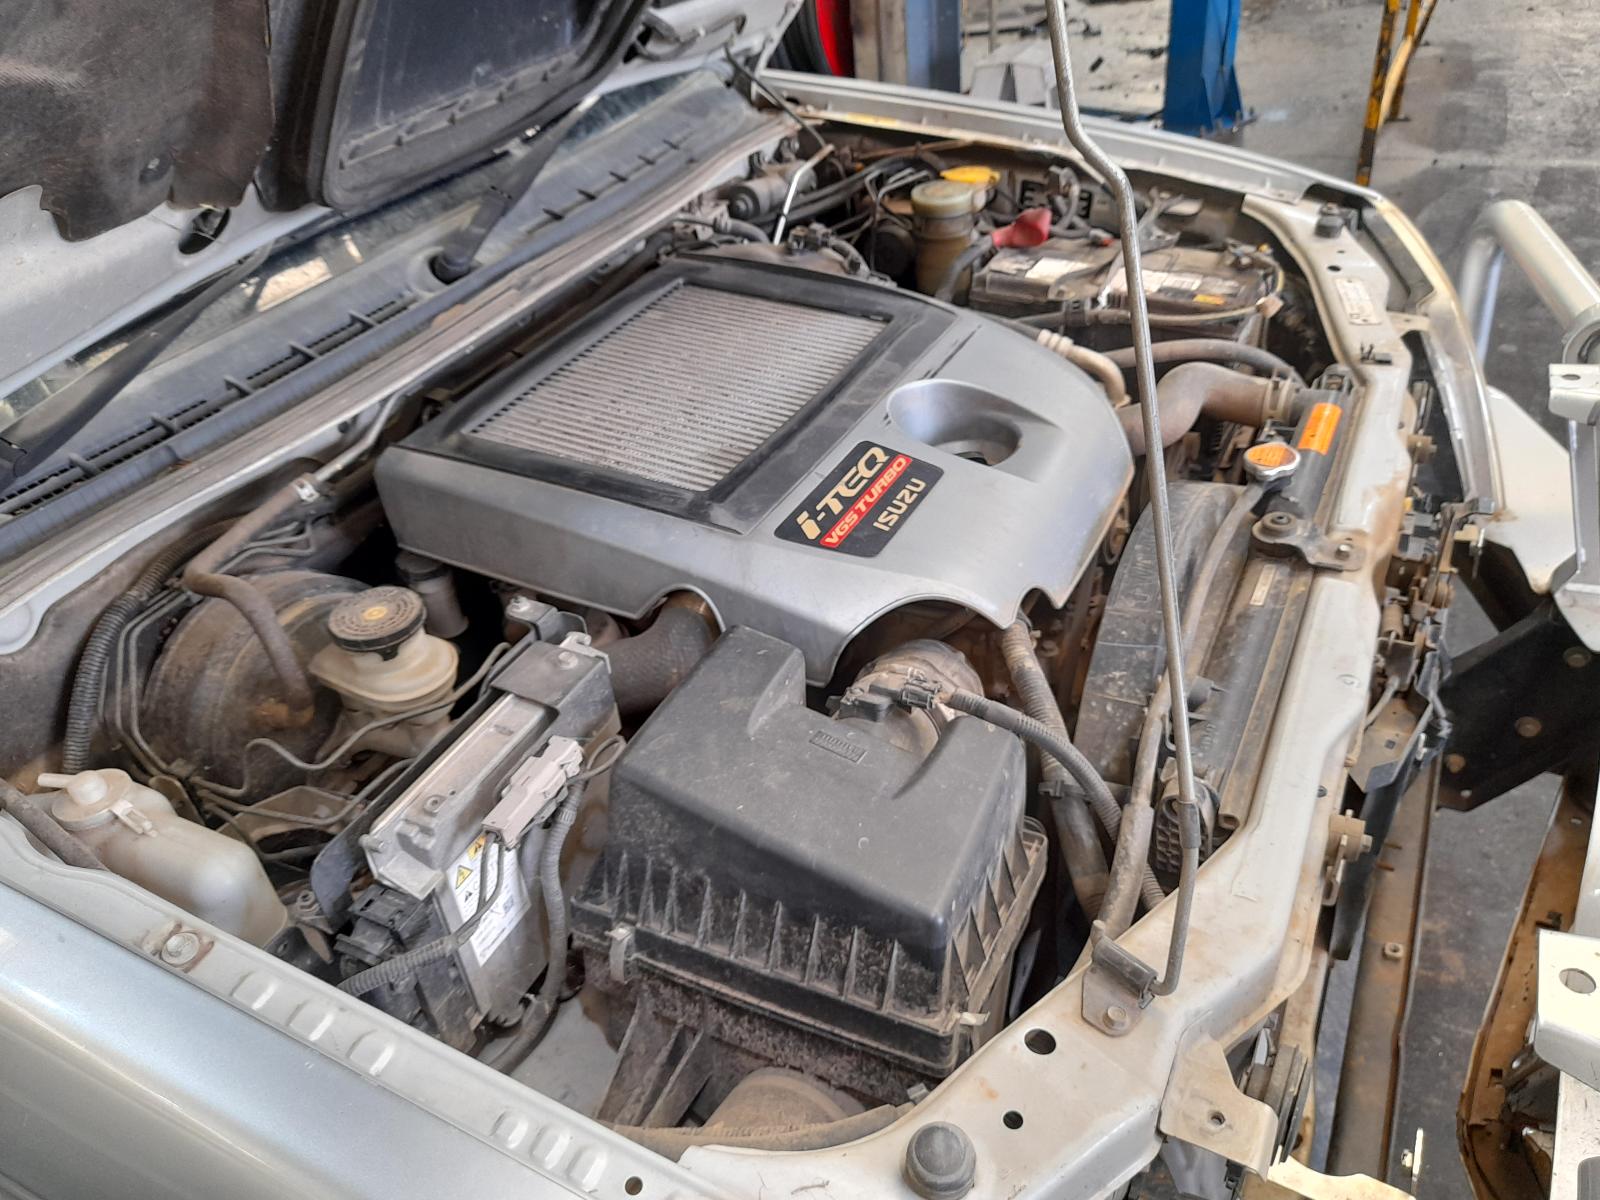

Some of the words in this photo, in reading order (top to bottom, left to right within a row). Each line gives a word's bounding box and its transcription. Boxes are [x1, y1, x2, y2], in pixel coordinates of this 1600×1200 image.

[796, 446, 890, 540] i-TEQ
[825, 512, 859, 544] VGS
[854, 457, 907, 512] TURBO
[872, 478, 927, 532] ISUZU
